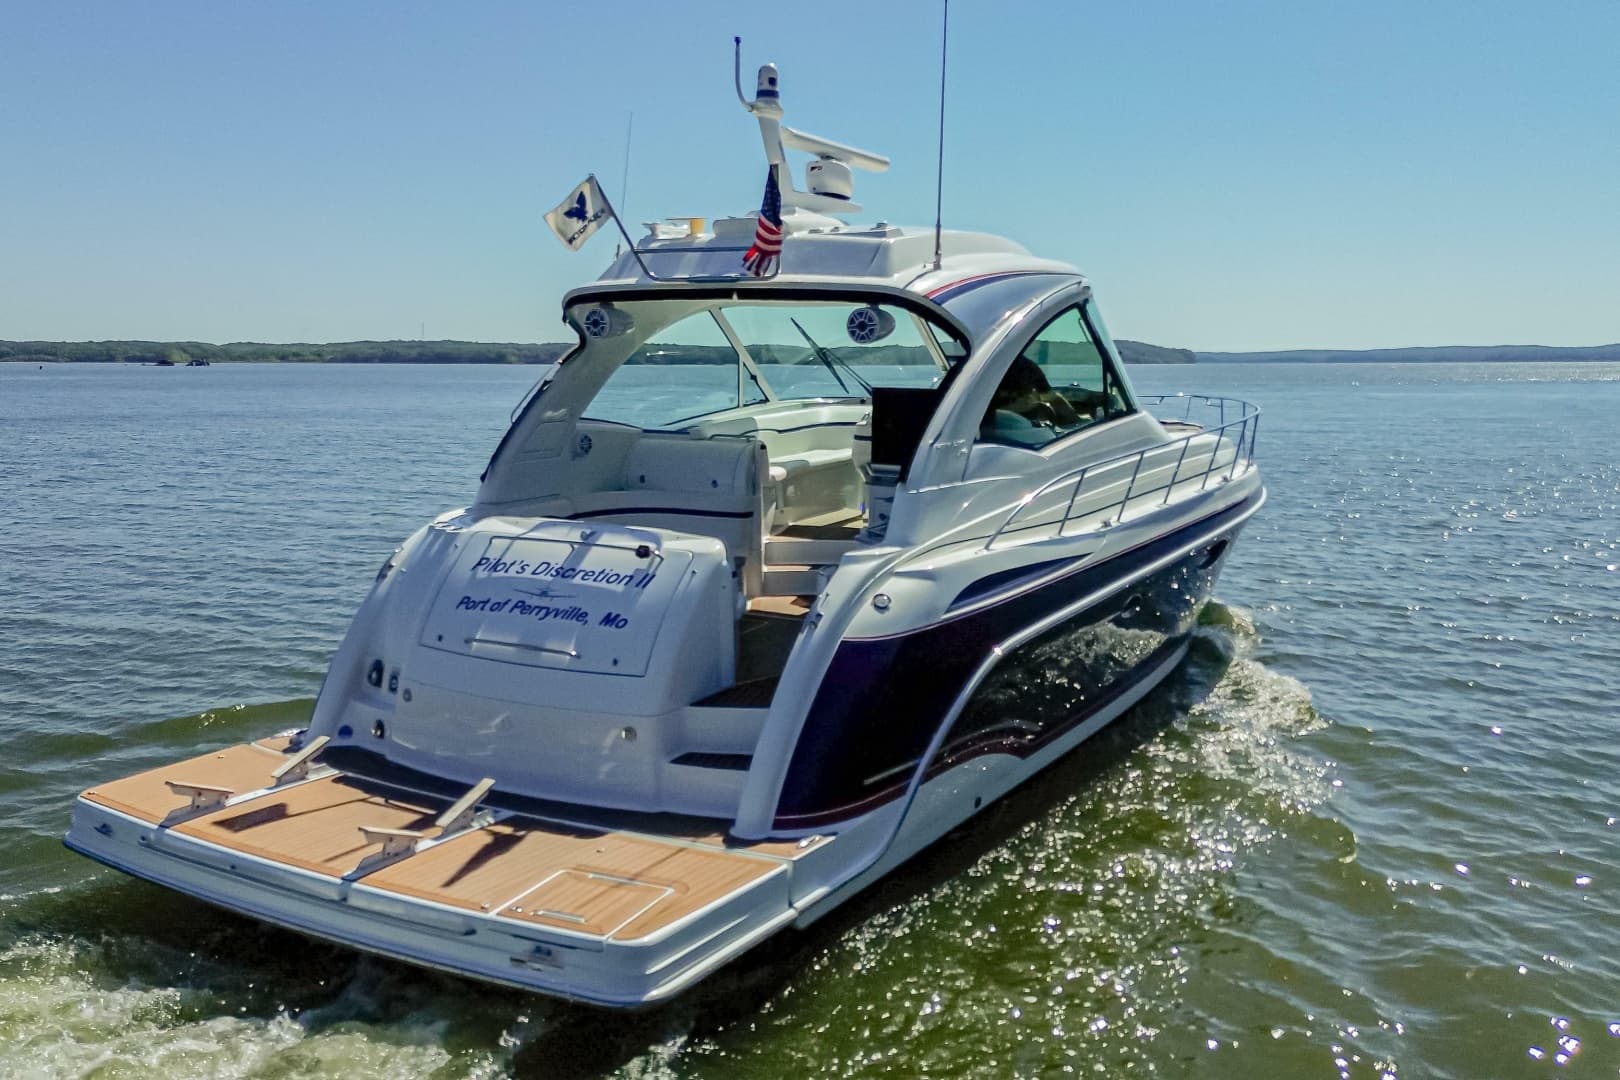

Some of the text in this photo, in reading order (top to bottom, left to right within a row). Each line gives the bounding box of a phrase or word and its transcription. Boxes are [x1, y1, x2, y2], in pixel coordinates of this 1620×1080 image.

[471, 557, 529, 576] Pilot's
[531, 561, 634, 587] Discretion
[456, 596, 628, 630] Port of Perryville, Mo
